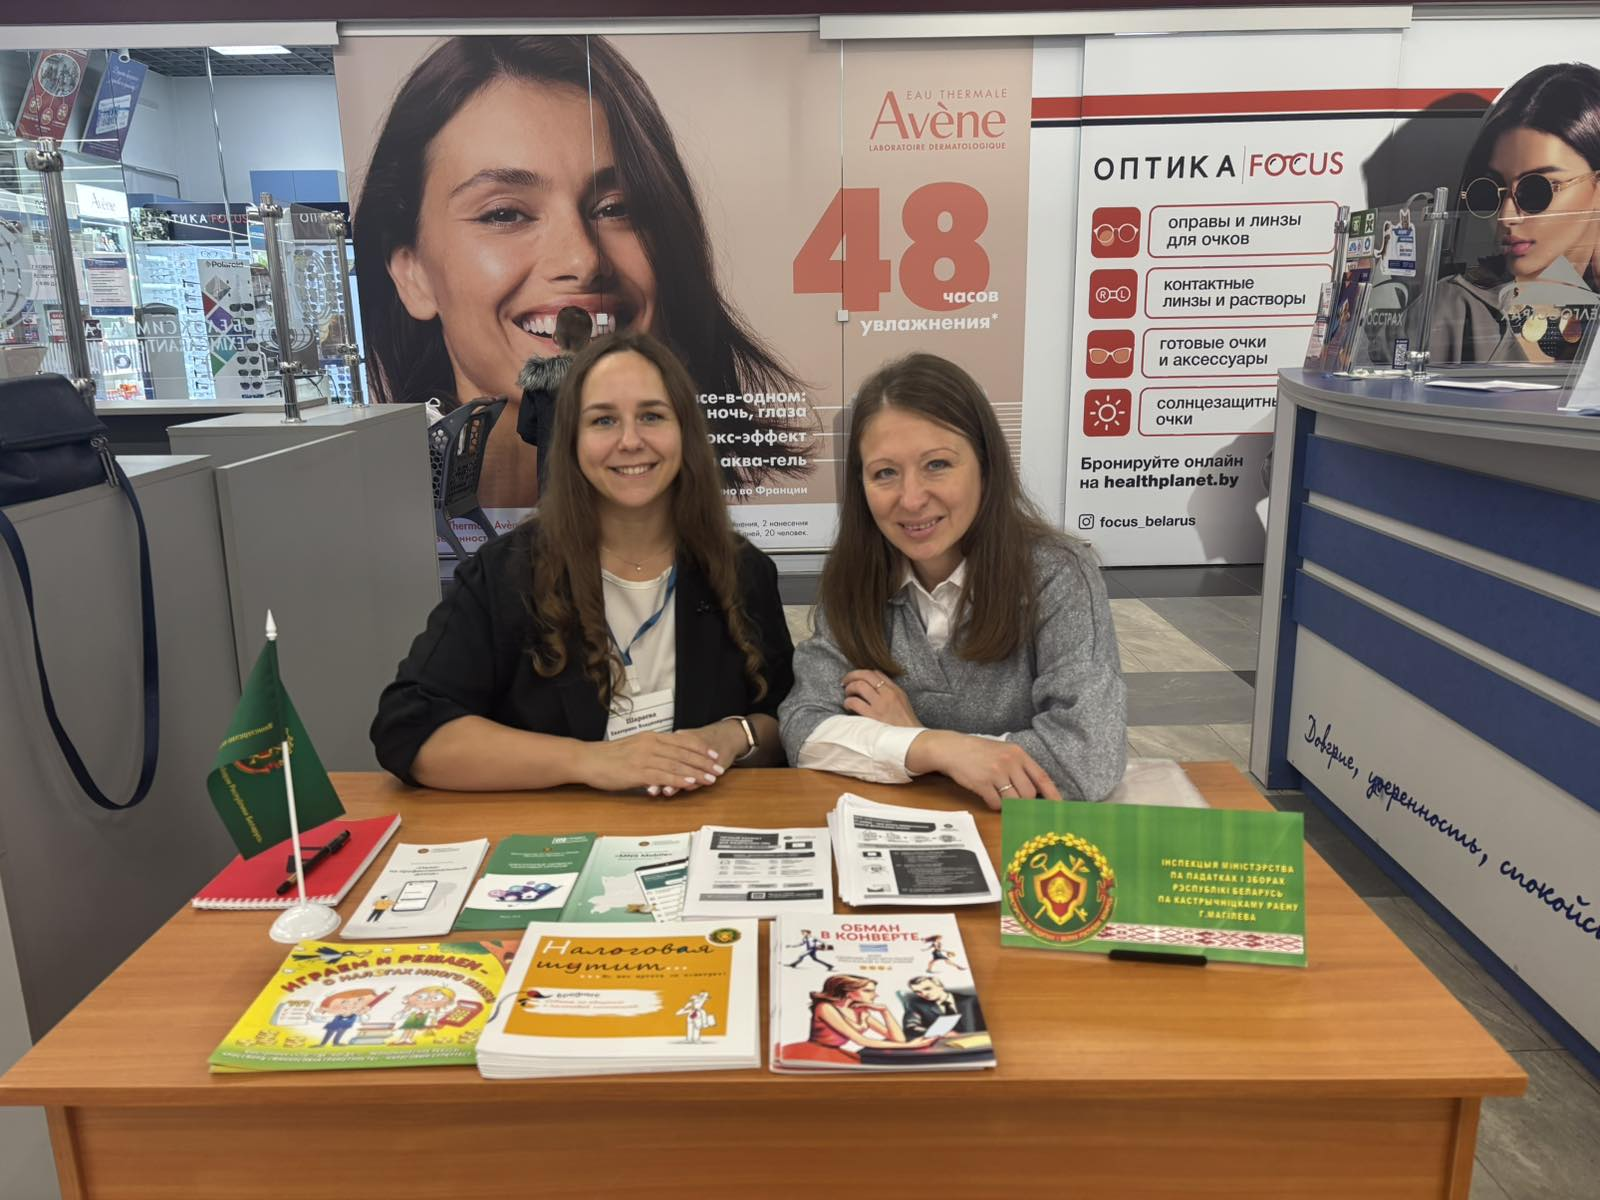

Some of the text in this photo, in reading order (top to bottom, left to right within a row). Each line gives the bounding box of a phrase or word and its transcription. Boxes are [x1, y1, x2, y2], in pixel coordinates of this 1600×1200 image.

[906, 88, 1008, 100] EAU THERMALE
[869, 91, 1006, 140] Avène
[869, 142, 1006, 152] LABORATOIRE DERMATOLOGIQUE
[1093, 151, 1344, 181] ОПТИКА FOCUS
[1167, 213, 1302, 231] оправы и линзы
[793, 181, 991, 313] 48
[1166, 233, 1250, 249] для очков
[1163, 278, 1255, 292] контактные
[943, 290, 999, 304] часов
[1162, 293, 1306, 309] линзы и растворы
[1159, 337, 1267, 350] готовые очки
[1159, 353, 1269, 369] и аксессуары
[1156, 397, 1278, 411] солнцезащитн
[707, 406, 807, 421] ночь, глаза
[1155, 414, 1193, 426] очки
[720, 456, 808, 468] аква-гель
[1081, 454, 1244, 471] Бронируйте онлайн
[1079, 475, 1240, 490] на healthplanet.by
[740, 488, 753, 496] во
[755, 486, 808, 497] Франции
[494, 520, 522, 530] Avèn
[1100, 515, 1196, 529] focus_belarus
[765, 528, 775, 537] 20
[1161, 858, 1295, 874] ІНСПЕКЦЫЯ МІНІСТЭРСТВА
[1170, 871, 1184, 880] ПА
[1186, 872, 1238, 883] ПАДАТКАХ
[1247, 875, 1286, 886] ЗБОРАХ
[1172, 883, 1284, 898] РЭСПУБЛІКІ БЕЛАРУСЬ
[1157, 895, 1171, 904] ПА
[1173, 896, 1265, 910] КАСТРЫЧНІЦКАМУ
[820, 931, 830, 939] В
[840, 923, 900, 933] ОБМАН
[541, 939, 714, 957] Налоговая
[281, 960, 369, 993] ИГРАЕМ
[376, 956, 391, 966] И
[322, 978, 336, 986] О
